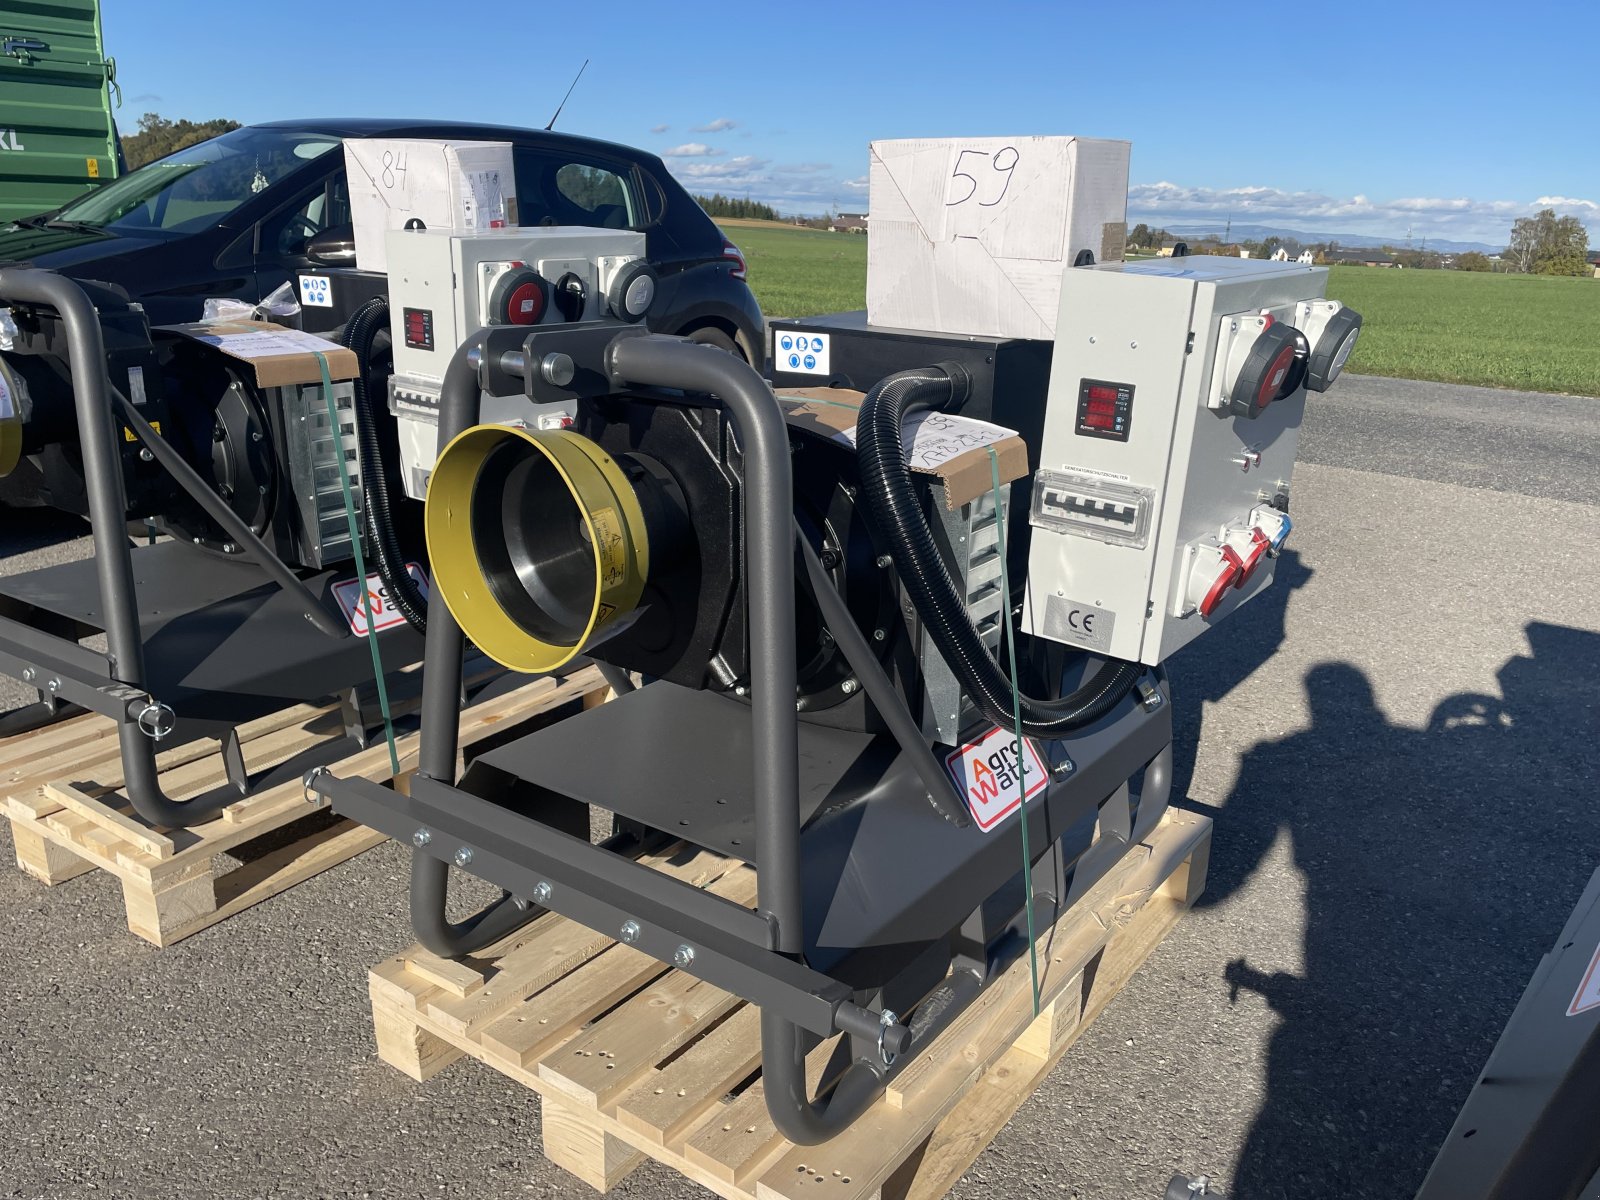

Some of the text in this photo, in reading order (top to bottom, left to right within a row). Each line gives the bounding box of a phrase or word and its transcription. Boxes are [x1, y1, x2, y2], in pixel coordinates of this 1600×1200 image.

[381, 150, 408, 191] 84
[945, 146, 1020, 207] 59
[1064, 465, 1129, 481] GENERATORSCHUTZSCHALTER
[1068, 610, 1095, 633] CE
